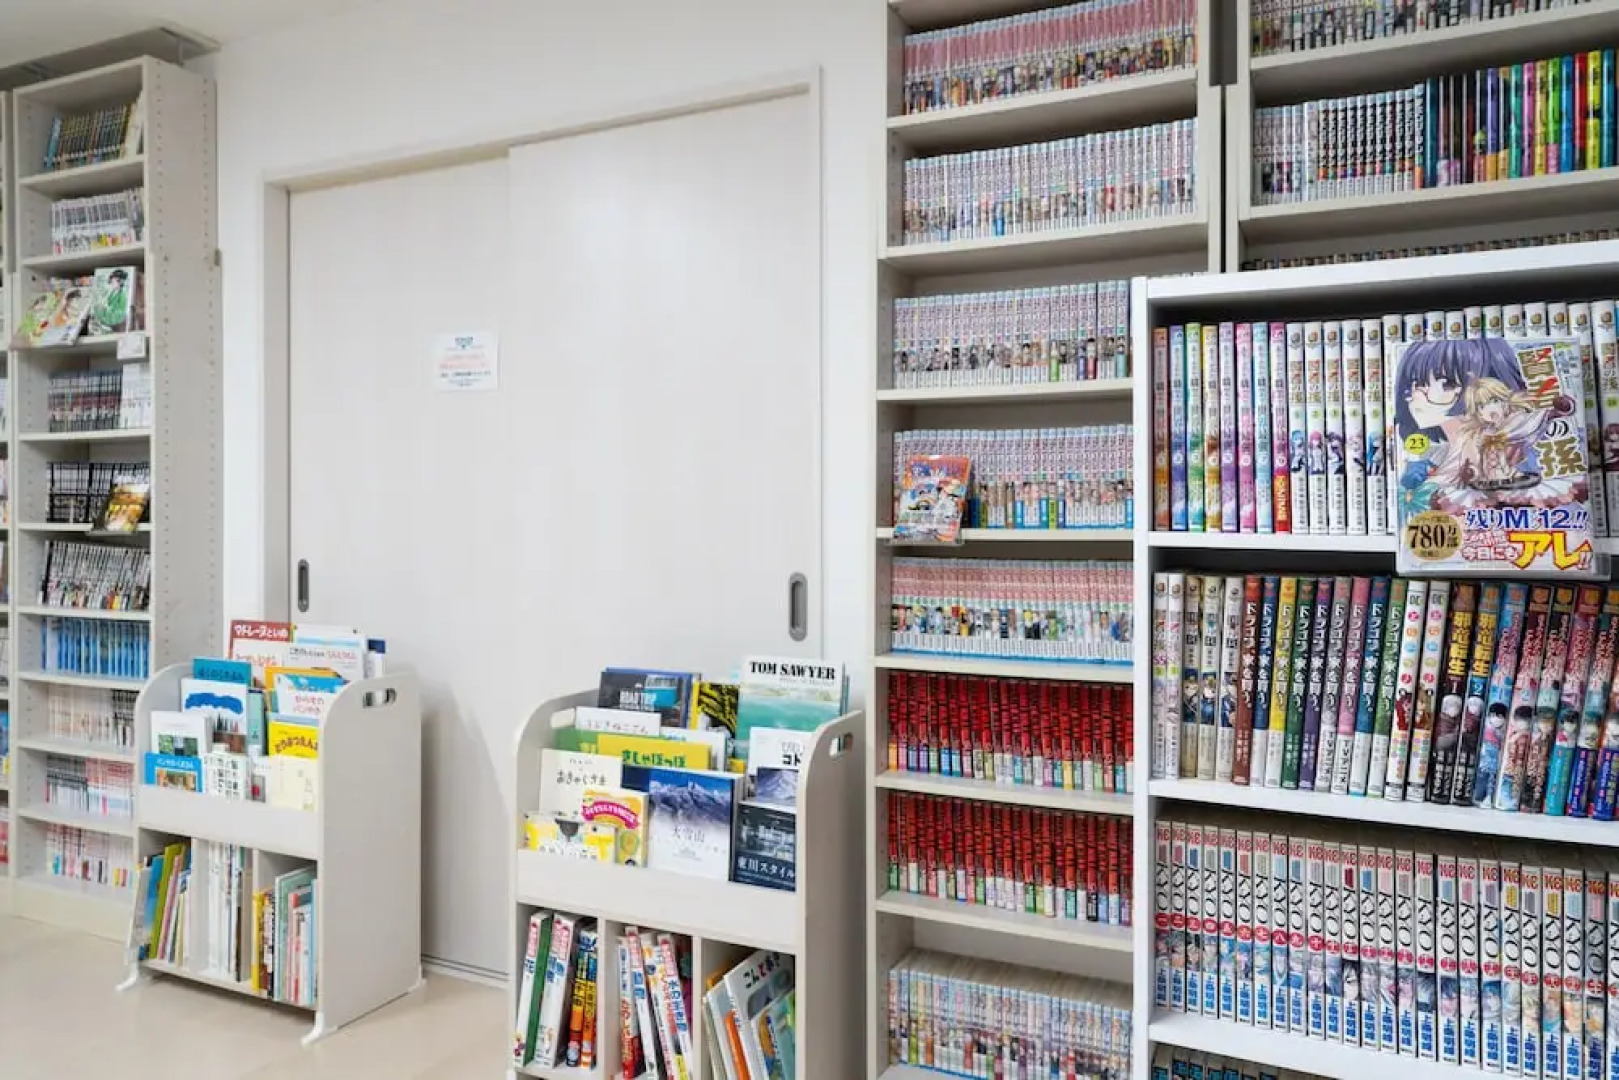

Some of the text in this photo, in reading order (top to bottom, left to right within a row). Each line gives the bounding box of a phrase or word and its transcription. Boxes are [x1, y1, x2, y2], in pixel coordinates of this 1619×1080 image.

[1409, 438, 1426, 450] 23
[750, 662, 835, 681] TOM SAWYER
[1156, 863, 1168, 910] KYO
[1172, 864, 1184, 911] KYO
[1187, 866, 1199, 915] KYO
[1204, 869, 1216, 916] KYO
[1221, 870, 1234, 918] KYO
[1238, 874, 1250, 923] KYO
[1255, 875, 1268, 923] KYO
[1273, 877, 1286, 927] KYO
[1291, 880, 1303, 930] KYO
[1309, 882, 1322, 933] KYO
[1325, 885, 1339, 936] KYO
[1343, 888, 1356, 939] KYO
[1361, 890, 1375, 941] KYO
[1379, 892, 1392, 944] KYO
[1398, 895, 1411, 947] KYO
[1418, 898, 1432, 951] KYO
[1441, 901, 1455, 954] KYO
[1461, 903, 1476, 956] KYO
[1484, 905, 1499, 958] KYO
[1505, 907, 1520, 961] KYO
[1523, 913, 1537, 968] KYO
[1545, 914, 1560, 969] KYO
[1566, 916, 1581, 971] KYO
[1589, 920, 1604, 974] KYO
